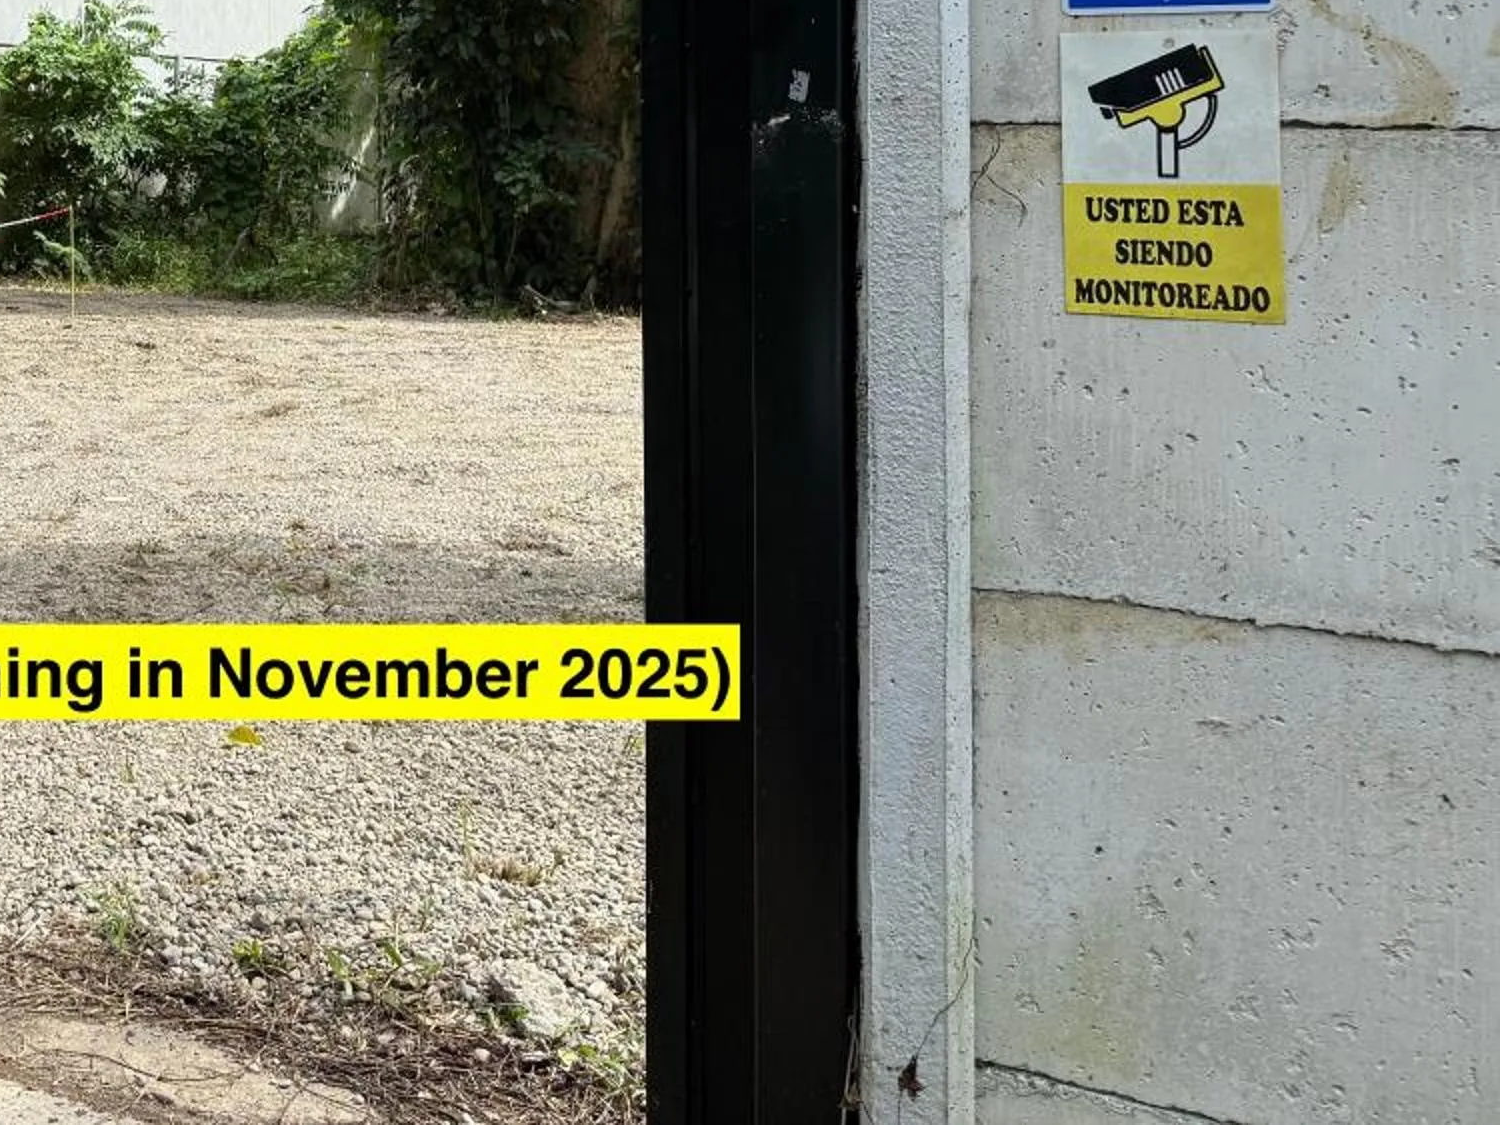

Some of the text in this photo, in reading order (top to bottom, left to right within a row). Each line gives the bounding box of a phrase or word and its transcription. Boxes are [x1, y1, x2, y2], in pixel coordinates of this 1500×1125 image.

[1086, 197, 1244, 226] USTED ESTA
[1115, 239, 1213, 267] SIENDO
[1075, 279, 1270, 312] MONITOREADO
